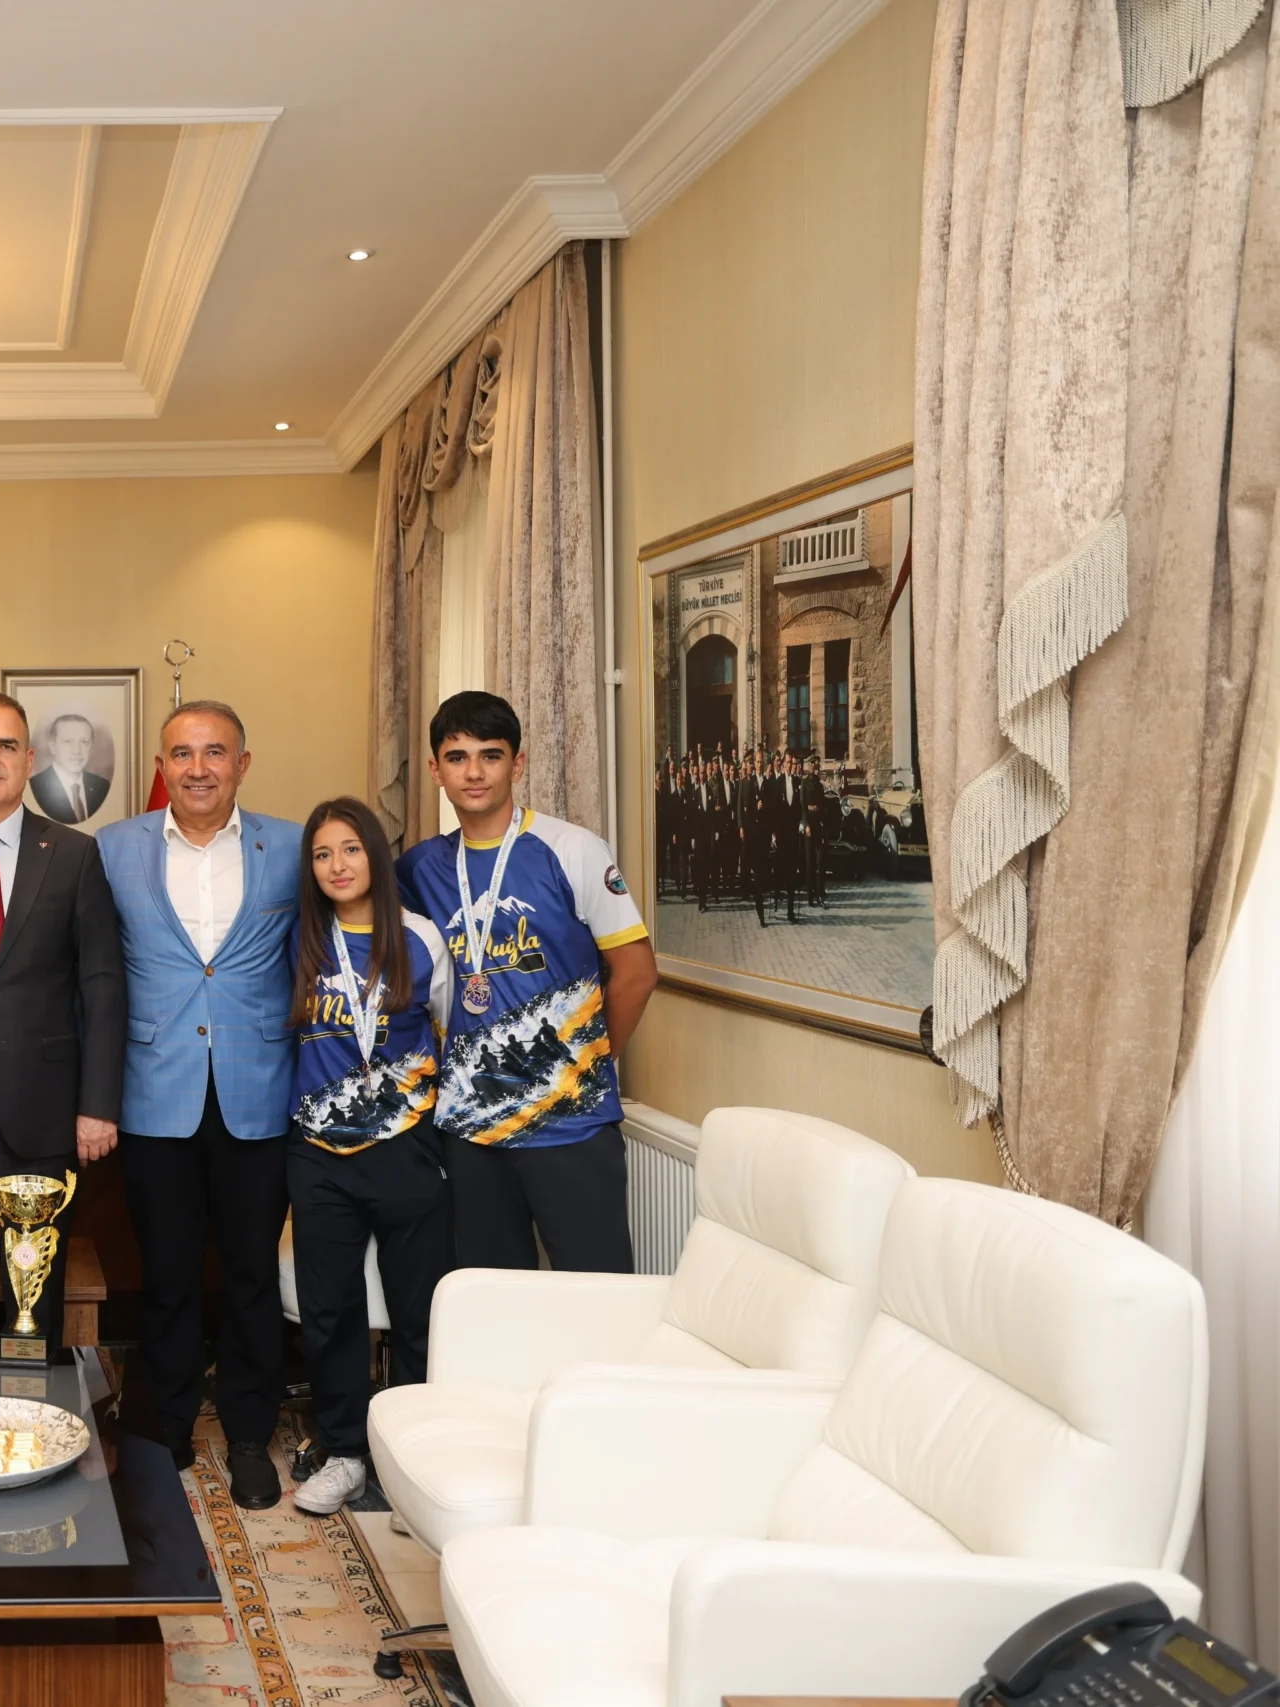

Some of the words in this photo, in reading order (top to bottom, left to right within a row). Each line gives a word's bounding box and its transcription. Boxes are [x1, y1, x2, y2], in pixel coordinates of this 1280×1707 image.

[699, 577, 724, 592] TÜRKİYE
[682, 597, 700, 611] BÜYÜK
[701, 595, 719, 608] MİLLET
[721, 589, 742, 606] MECLİSİ
